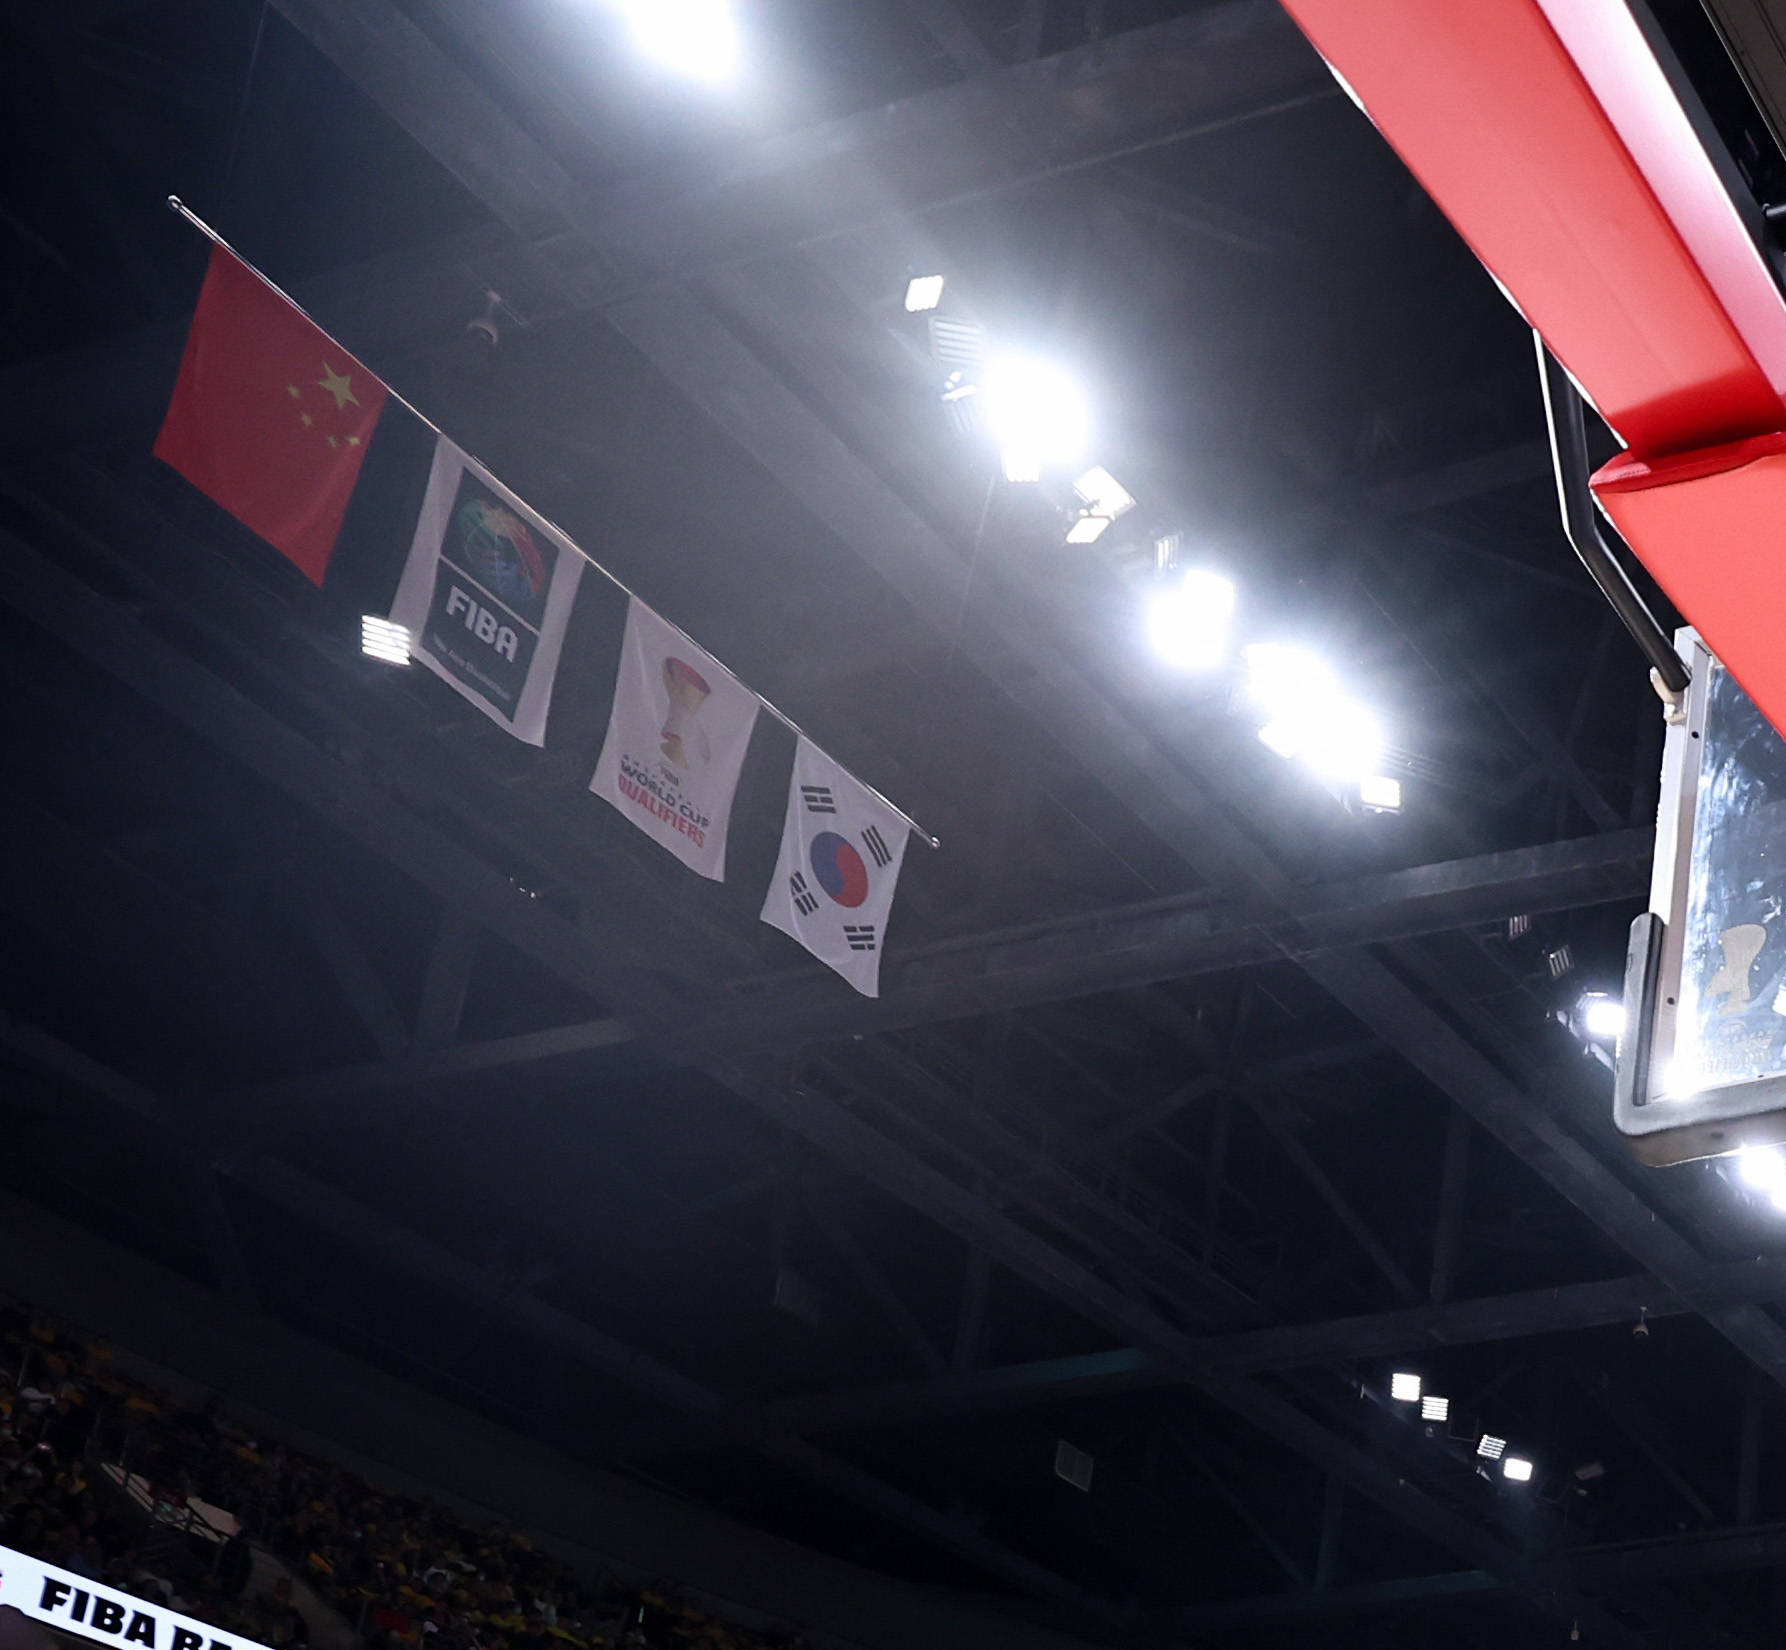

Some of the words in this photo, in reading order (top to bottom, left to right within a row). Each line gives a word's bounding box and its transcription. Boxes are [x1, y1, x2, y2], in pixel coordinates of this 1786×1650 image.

[445, 584, 519, 663] FIBA
[617, 773, 706, 848] QUALIFIERS
[620, 758, 676, 806] WORLD
[679, 802, 711, 829] CUP
[39, 1575, 157, 1650] FIBA
